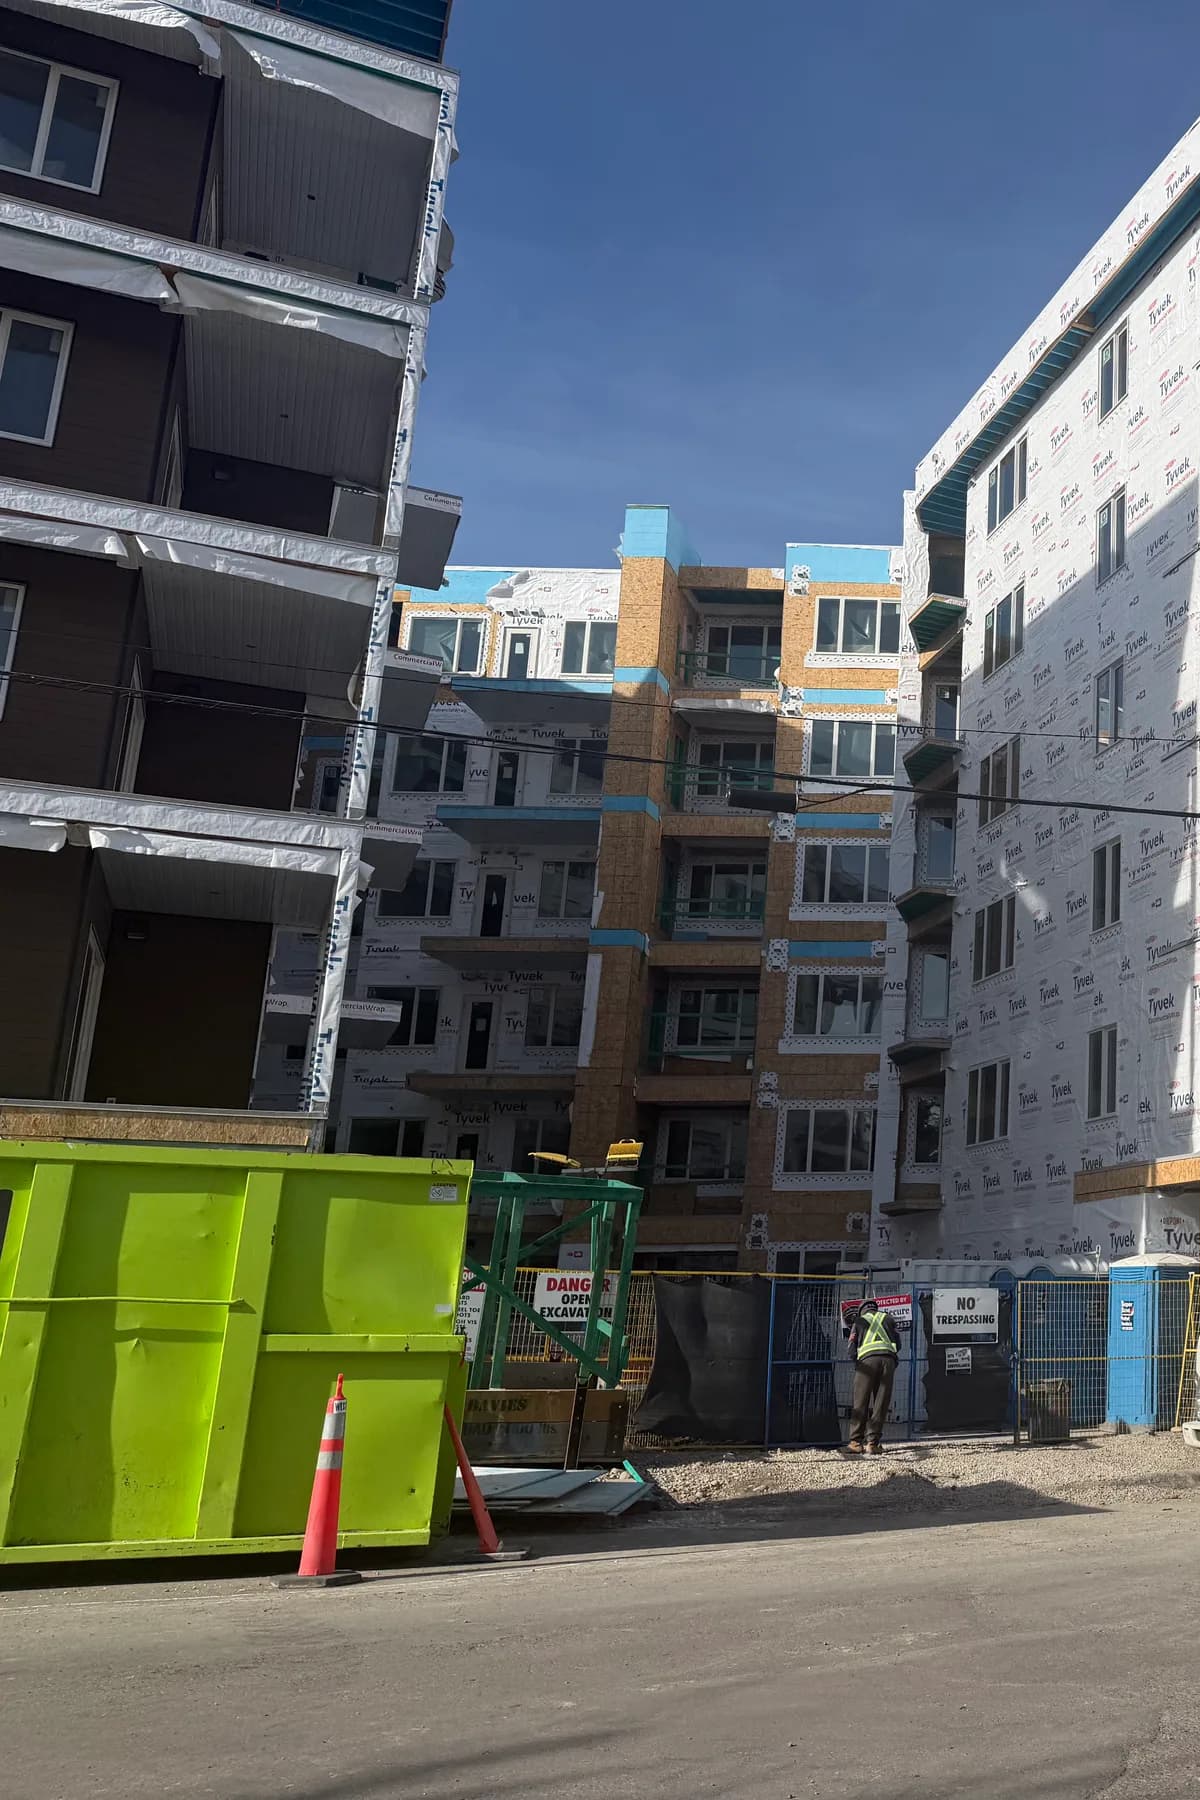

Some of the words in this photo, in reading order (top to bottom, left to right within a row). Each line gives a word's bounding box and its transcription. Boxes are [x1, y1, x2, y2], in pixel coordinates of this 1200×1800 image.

[1148, 294, 1172, 325] Tyvek
[1159, 365, 1184, 397] Tyvek
[1082, 390, 1098, 413] Tyve
[1051, 422, 1069, 449] Tyvek
[1092, 450, 1113, 477] Tyvek
[1165, 457, 1191, 486] Tyvek
[1060, 483, 1079, 509] Tyvek
[1031, 512, 1050, 536] Tyvek
[1003, 542, 1021, 564] Tyvek
[977, 569, 993, 591] Tyvek
[1057, 568, 1077, 593] Tyvek
[1164, 599, 1189, 628] Tyvek
[1064, 638, 1084, 662] Tyvek
[1033, 664, 1051, 688] Tyvek
[1003, 688, 1021, 709] Tyvek
[977, 711, 993, 731] Tyvek
[1171, 699, 1197, 728] Tyvek
[1059, 809, 1080, 831] Tyvek
[1034, 827, 1053, 848] Tyvek
[1139, 831, 1164, 858] Tyvek
[514, 893, 535, 903] vek
[1066, 894, 1088, 917] Tyvek
[508, 971, 543, 982] Tyvek
[1073, 972, 1094, 993] Tyvek
[1039, 984, 1059, 1004] Tyvek
[1148, 994, 1174, 1019] Tyvek
[1019, 1092, 1038, 1110] Tyvek
[1052, 1081, 1072, 1101] Tyvek
[1169, 1091, 1194, 1114] Tyvek
[1012, 1169, 1032, 1188] Tyvek
[1046, 1160, 1067, 1178] Tyvek
[1110, 1231, 1135, 1249] Tyvek
[1164, 1229, 1200, 1249] Tyve
[546, 1278, 610, 1292] DANGR
[540, 1307, 612, 1318] EXCAVATON
[957, 1297, 975, 1310] NO
[936, 1315, 995, 1325] TRESPASSING
